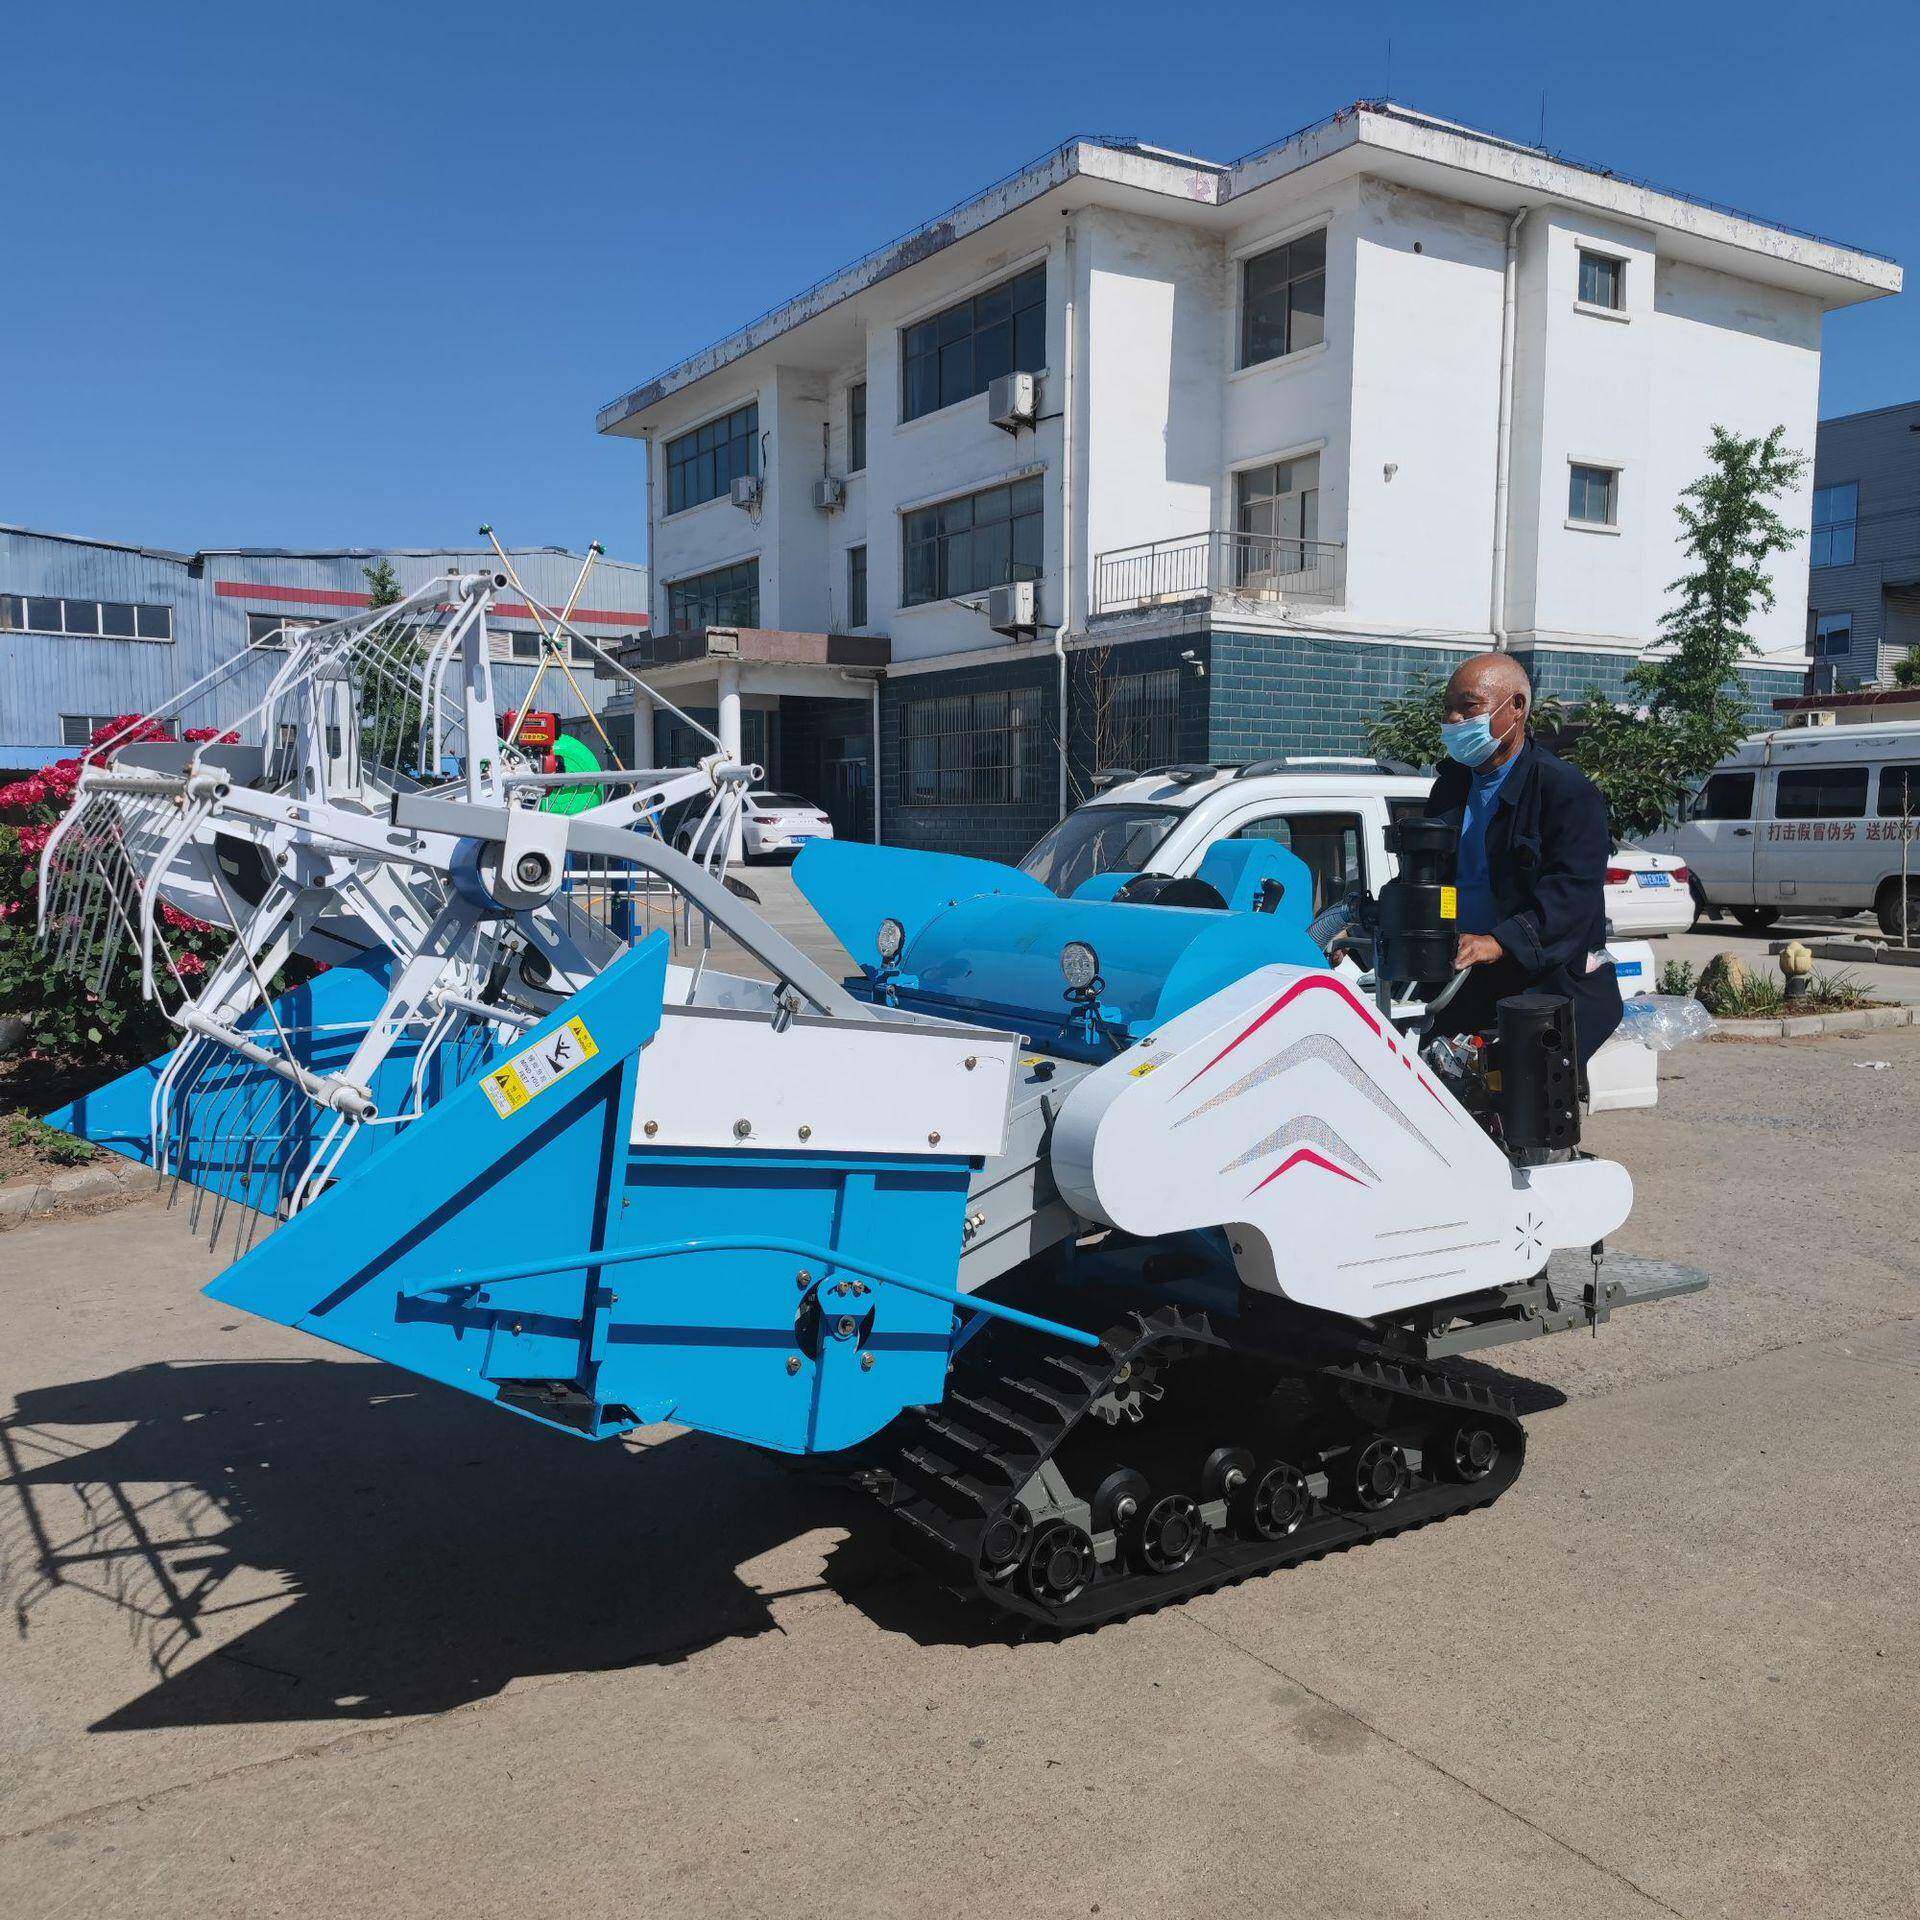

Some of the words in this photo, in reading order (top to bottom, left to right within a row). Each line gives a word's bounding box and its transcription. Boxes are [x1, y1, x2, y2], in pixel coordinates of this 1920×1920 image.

[1768, 821, 1857, 841] 打击假冒伪劣
